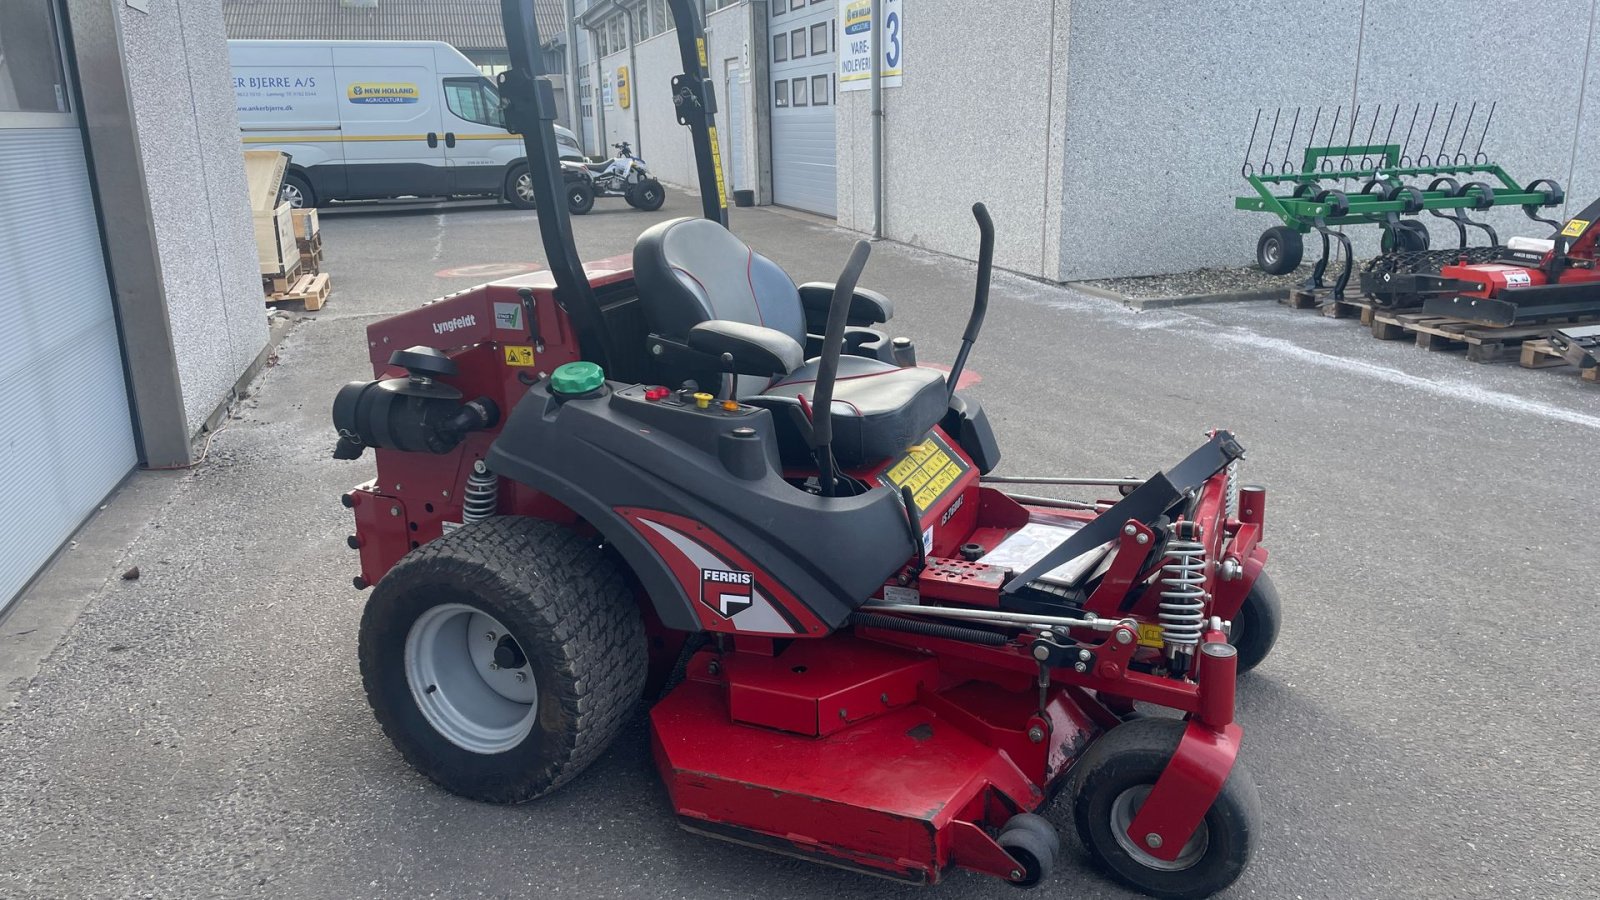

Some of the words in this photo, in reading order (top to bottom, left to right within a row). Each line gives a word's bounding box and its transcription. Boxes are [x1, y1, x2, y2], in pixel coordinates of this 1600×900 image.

[886, 12, 900, 68] 3
[249, 77, 291, 89] BJERRE
[294, 77, 316, 88] A/S
[432, 314, 476, 334] Lyngfeldt
[704, 570, 751, 584] FERRIS
